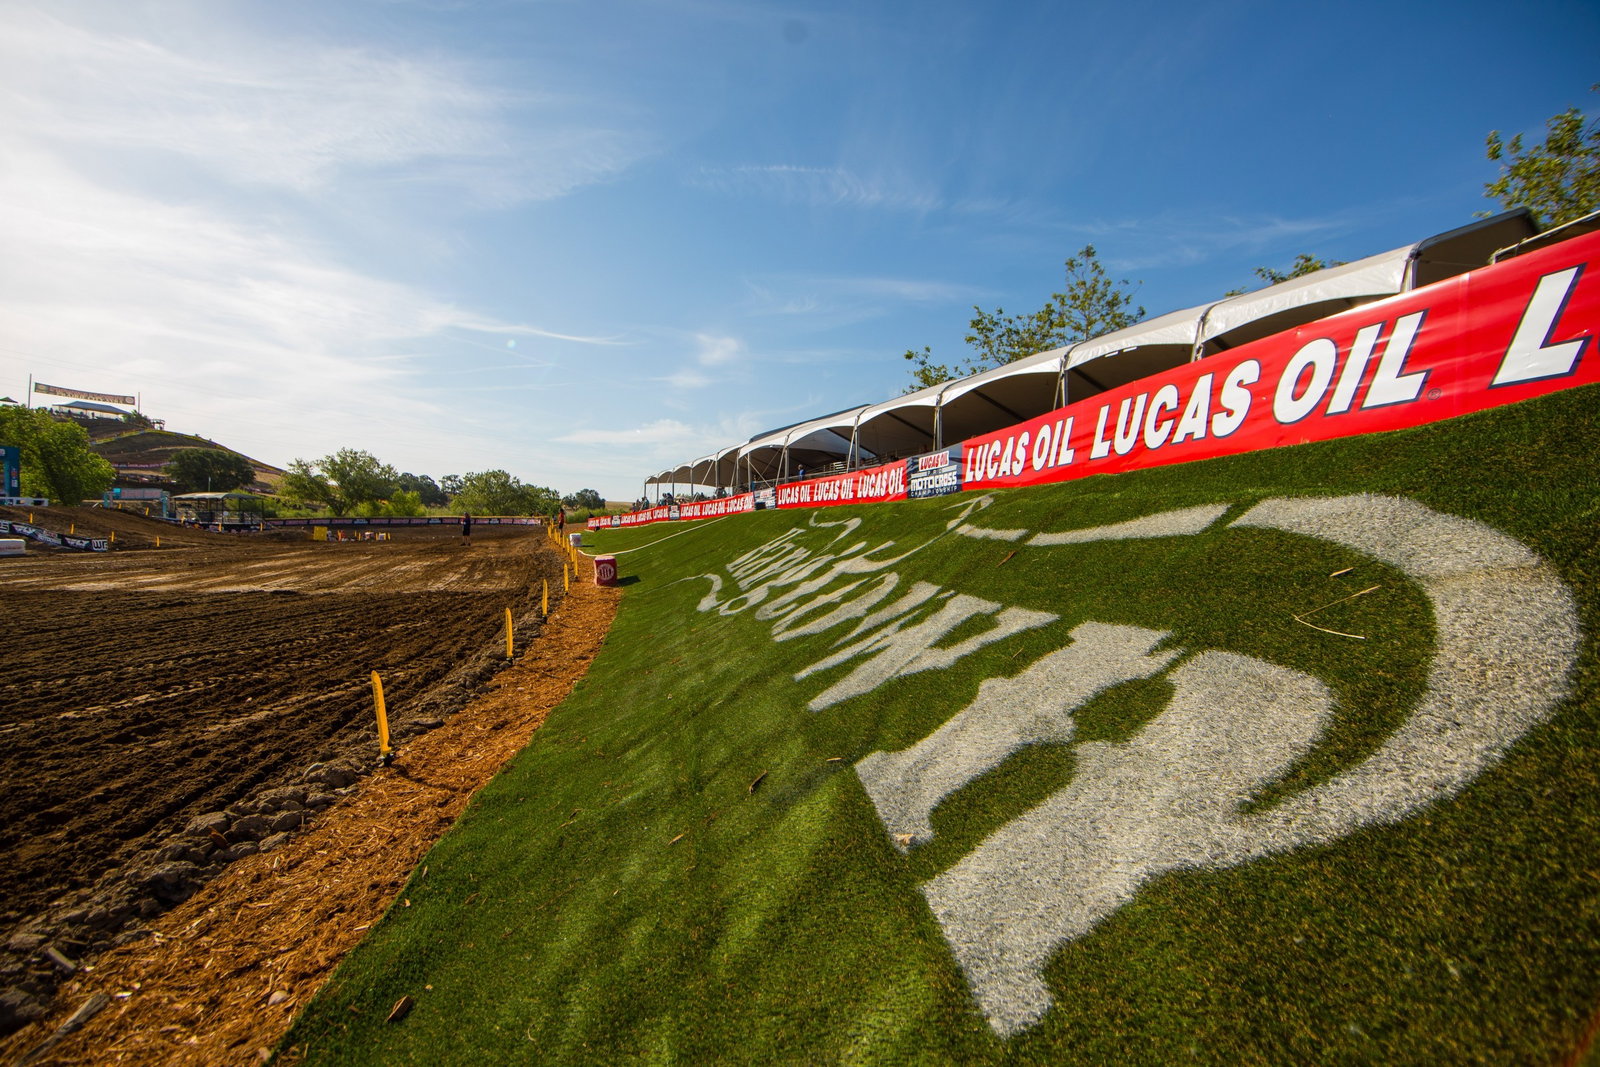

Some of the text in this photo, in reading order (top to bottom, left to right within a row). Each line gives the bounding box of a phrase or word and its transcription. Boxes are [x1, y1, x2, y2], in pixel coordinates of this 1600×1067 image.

[1488, 262, 1600, 389] L
[1089, 308, 1432, 461] LUCAS OIL
[964, 416, 1075, 484] LUCAS OIL
[920, 452, 948, 470] LUCAS OIL
[813, 478, 854, 501] LUCAS OIL
[857, 467, 905, 498] LUCAS OIL
[911, 471, 957, 491] MOTOCROSS
[778, 488, 799, 505] LUCAS
[800, 486, 811, 502] OIL
[910, 486, 957, 496] CHAMPIONSHIP
[681, 505, 694, 517] LUCAS
[702, 502, 717, 516] LUCAS
[727, 497, 744, 513] LUCAS
